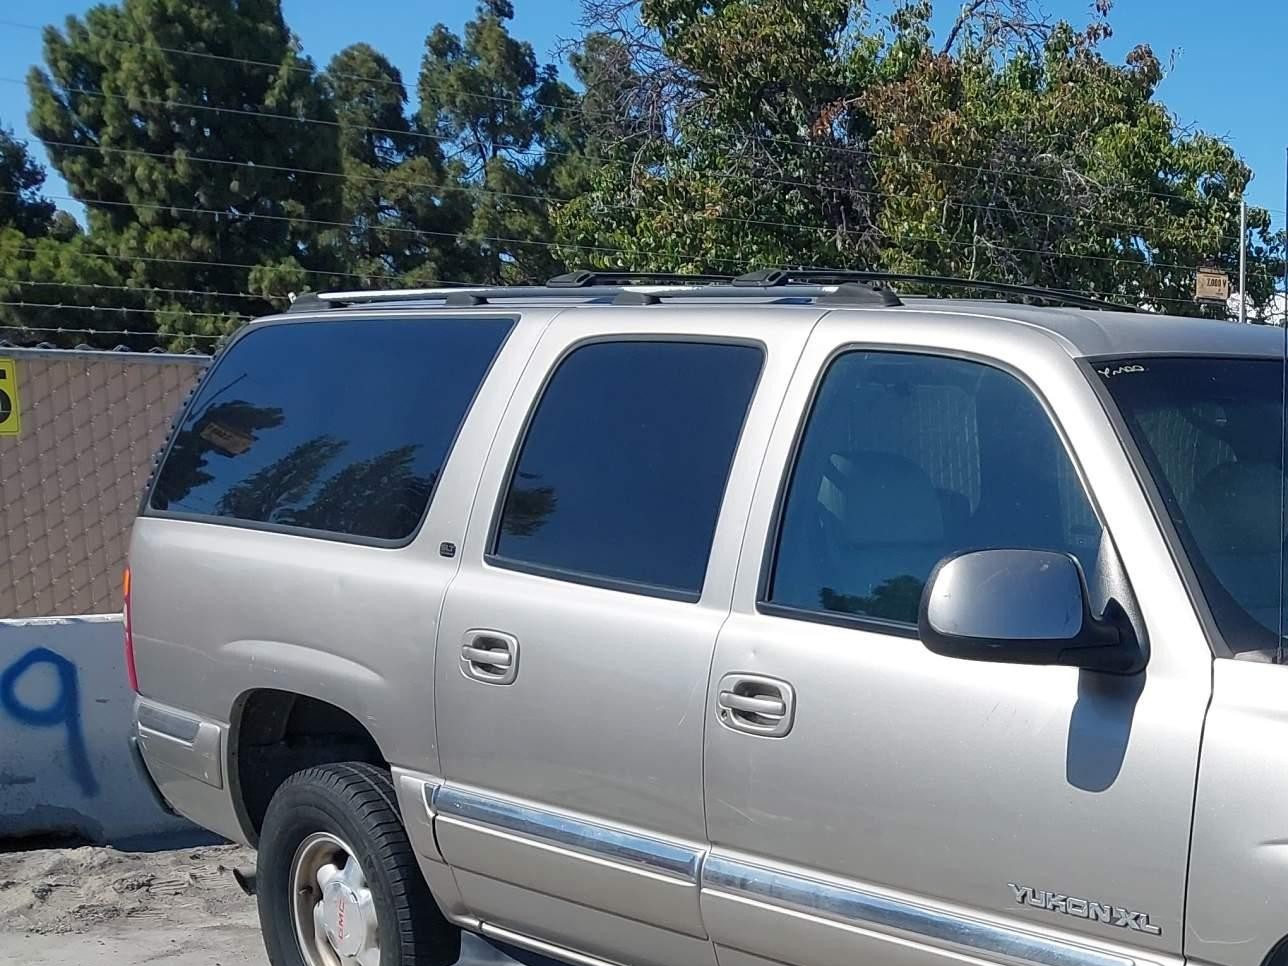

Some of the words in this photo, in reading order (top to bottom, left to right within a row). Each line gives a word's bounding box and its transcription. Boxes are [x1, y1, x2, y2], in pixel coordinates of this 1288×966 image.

[0, 647, 99, 798] 9
[1007, 883, 1112, 924] YUKON
[1110, 907, 1162, 936] XL
